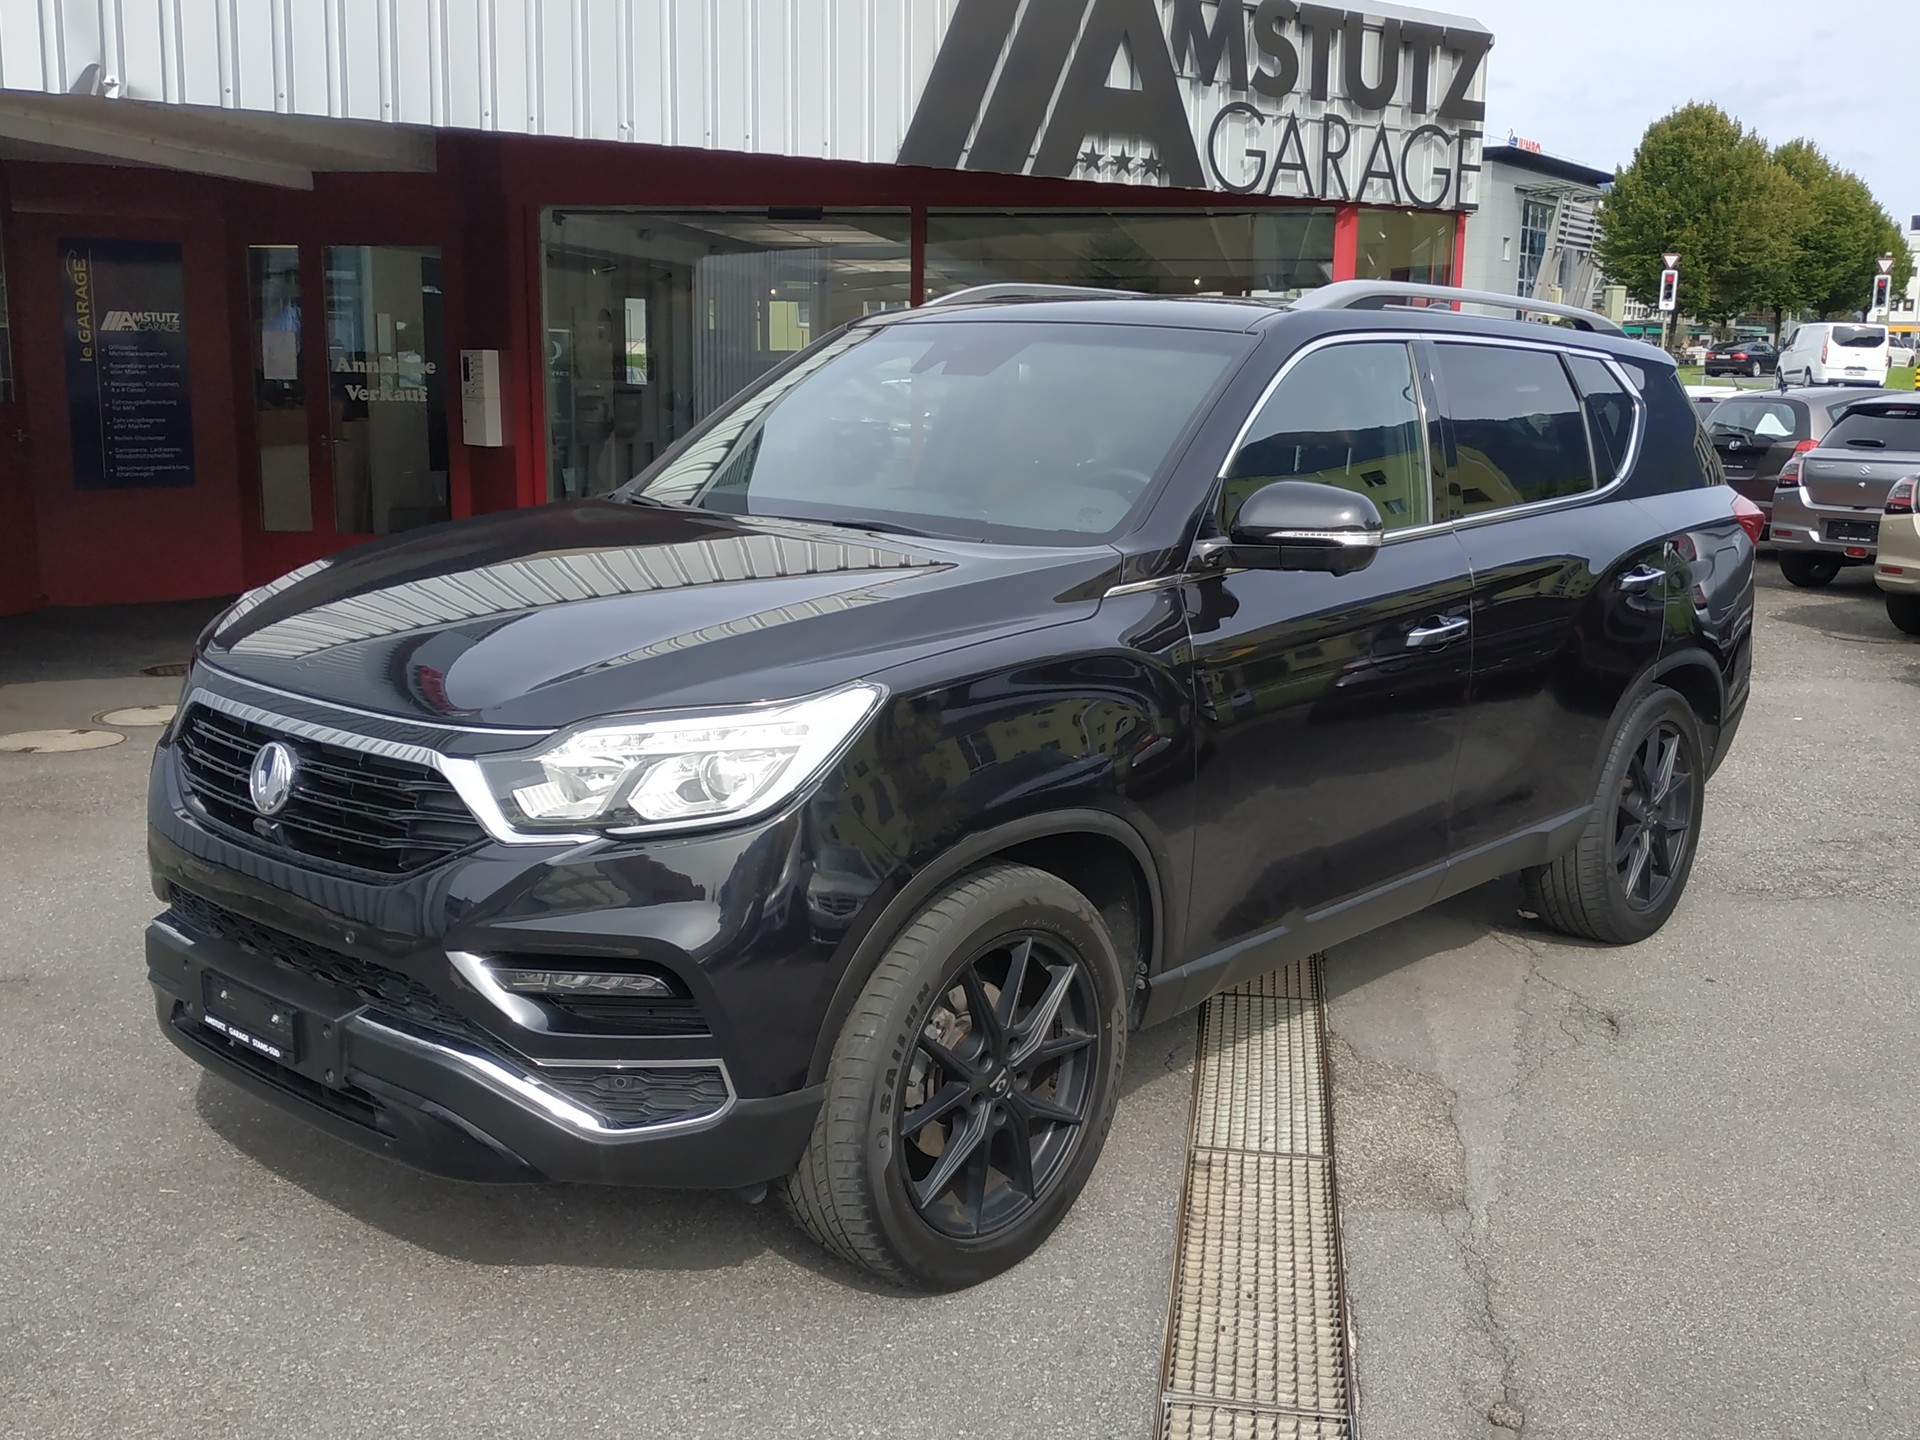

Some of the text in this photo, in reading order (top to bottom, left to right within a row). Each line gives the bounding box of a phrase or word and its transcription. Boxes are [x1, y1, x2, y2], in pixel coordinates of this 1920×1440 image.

[1029, 0, 1494, 188] AMSTUTZ
[1207, 101, 1483, 210] GARAGE
[73, 259, 93, 362] le GARAGE
[116, 311, 180, 331] AMSTUTZ
[138, 322, 180, 333] GARAGE
[345, 384, 428, 402] Verkauf
[228, 1027, 250, 1043] GARAGE
